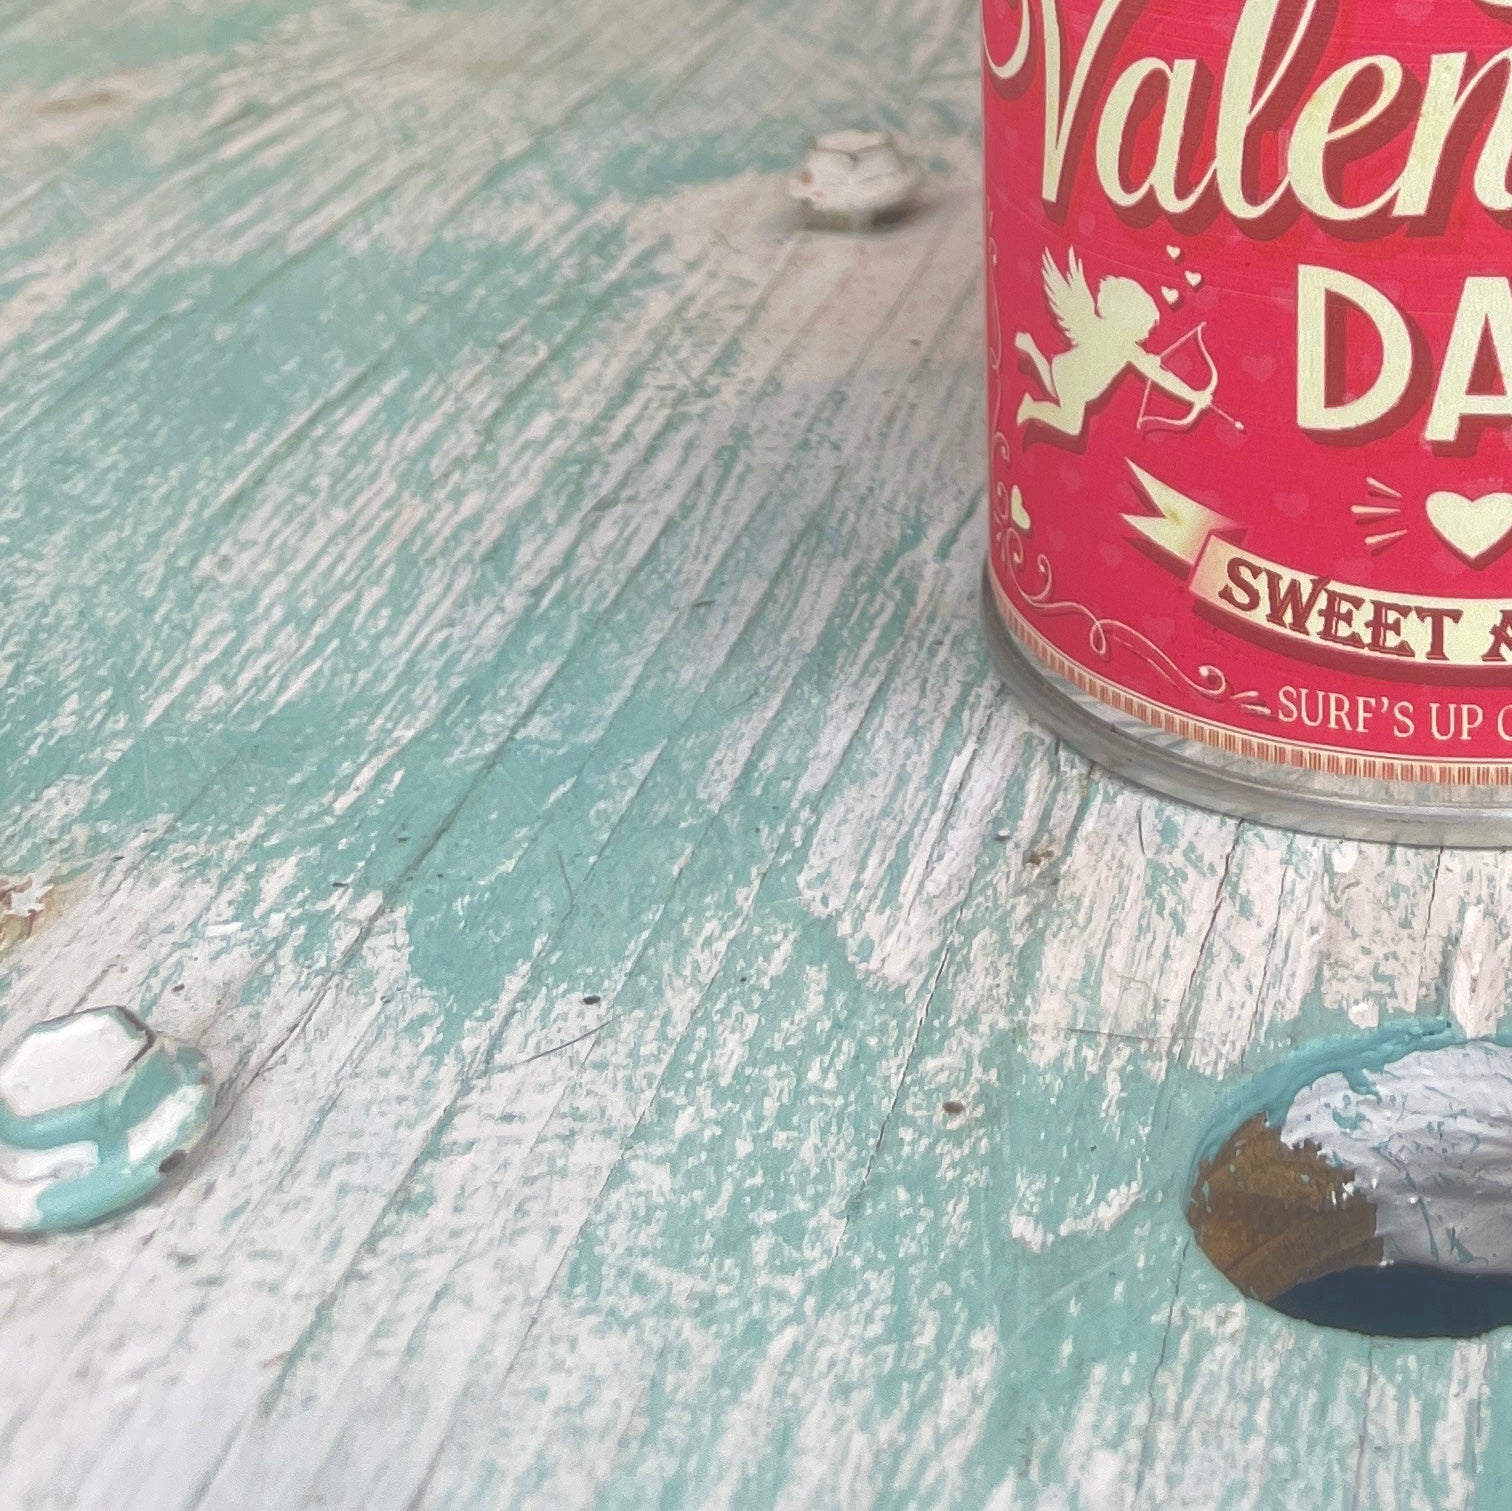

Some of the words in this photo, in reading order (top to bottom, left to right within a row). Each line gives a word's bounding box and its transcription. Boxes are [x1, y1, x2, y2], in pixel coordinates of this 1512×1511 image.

[1217, 556, 1465, 662] SWEET
[1277, 686, 1415, 738] SURF'S
[1429, 701, 1484, 741] UP
